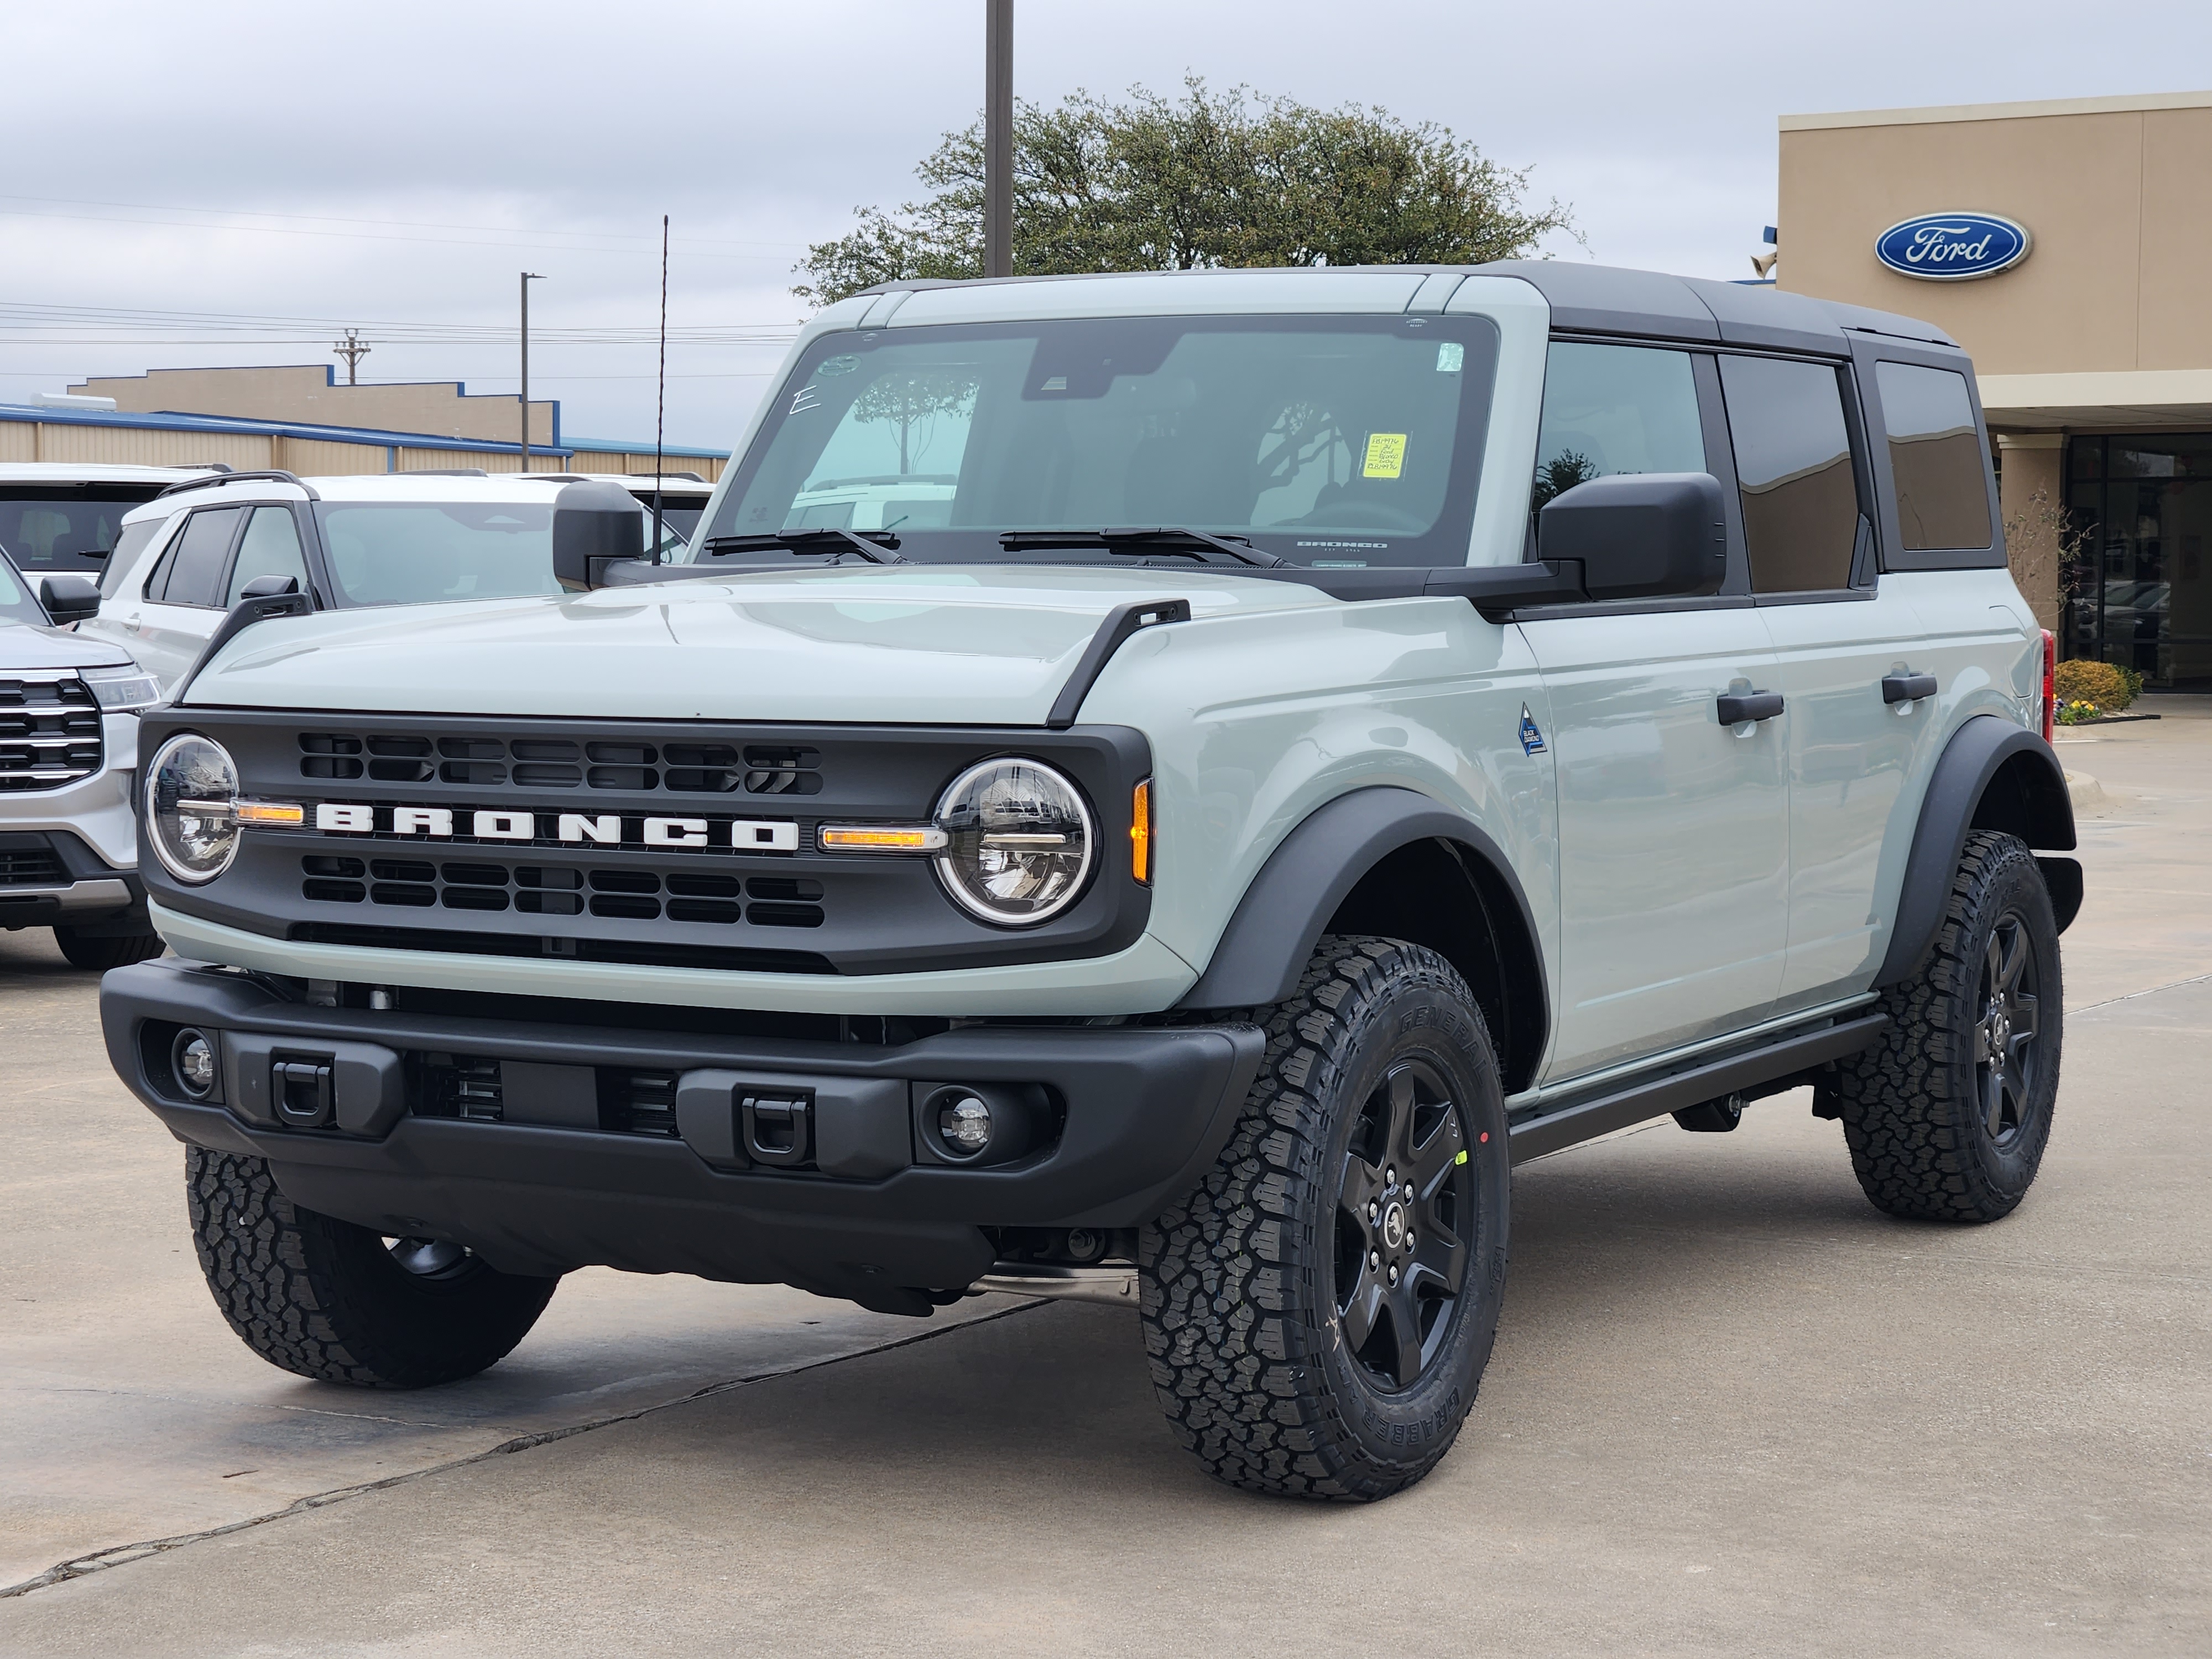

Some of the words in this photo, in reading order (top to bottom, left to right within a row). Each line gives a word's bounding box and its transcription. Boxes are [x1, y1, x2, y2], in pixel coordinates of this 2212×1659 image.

[1906, 227, 1992, 262] Ford
[789, 385, 821, 415] E
[316, 804, 799, 851] BRONCO
[1398, 1005, 1487, 1088] GENERAL
[1362, 1386, 1460, 1446] GRABBER
